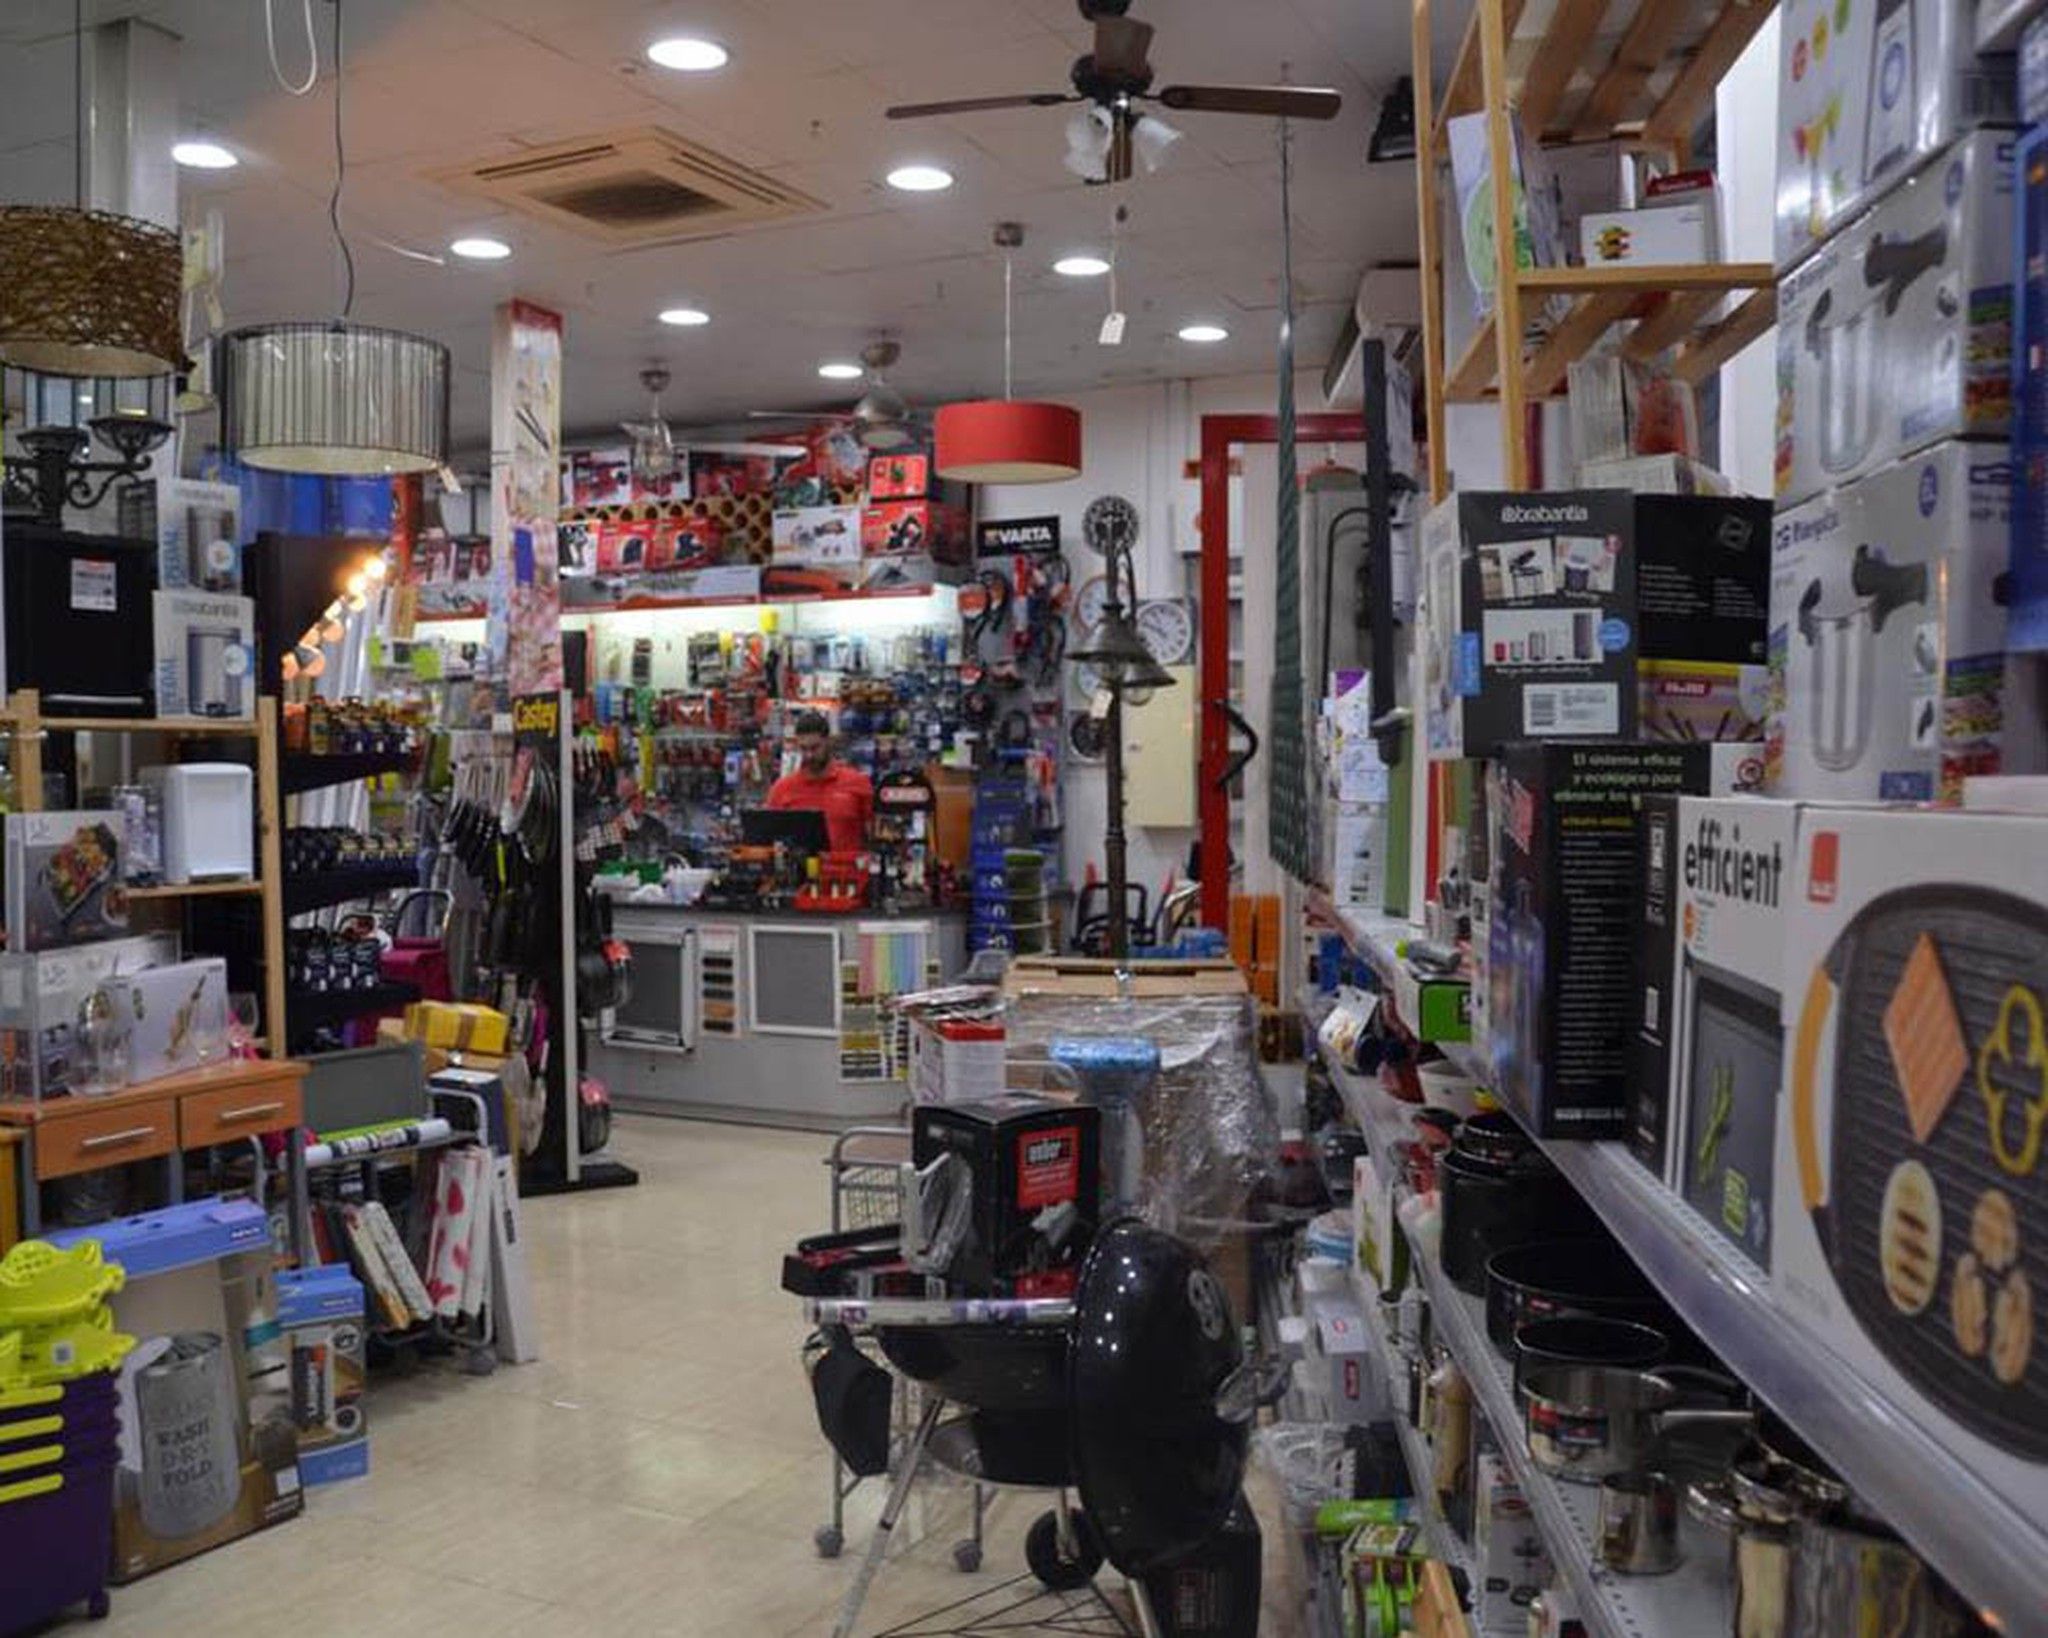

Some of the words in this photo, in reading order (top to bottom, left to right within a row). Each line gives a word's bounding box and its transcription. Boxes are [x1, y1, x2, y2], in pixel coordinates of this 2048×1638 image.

[1515, 504, 1589, 523] brabantia
[998, 525, 1052, 545] VARTA
[512, 698, 558, 738] Castey
[1572, 752, 1587, 767] El
[1589, 753, 1640, 767] sistema
[1643, 752, 1684, 767] eficaz
[1652, 773, 1683, 787] para
[1684, 817, 1782, 909] efficient
